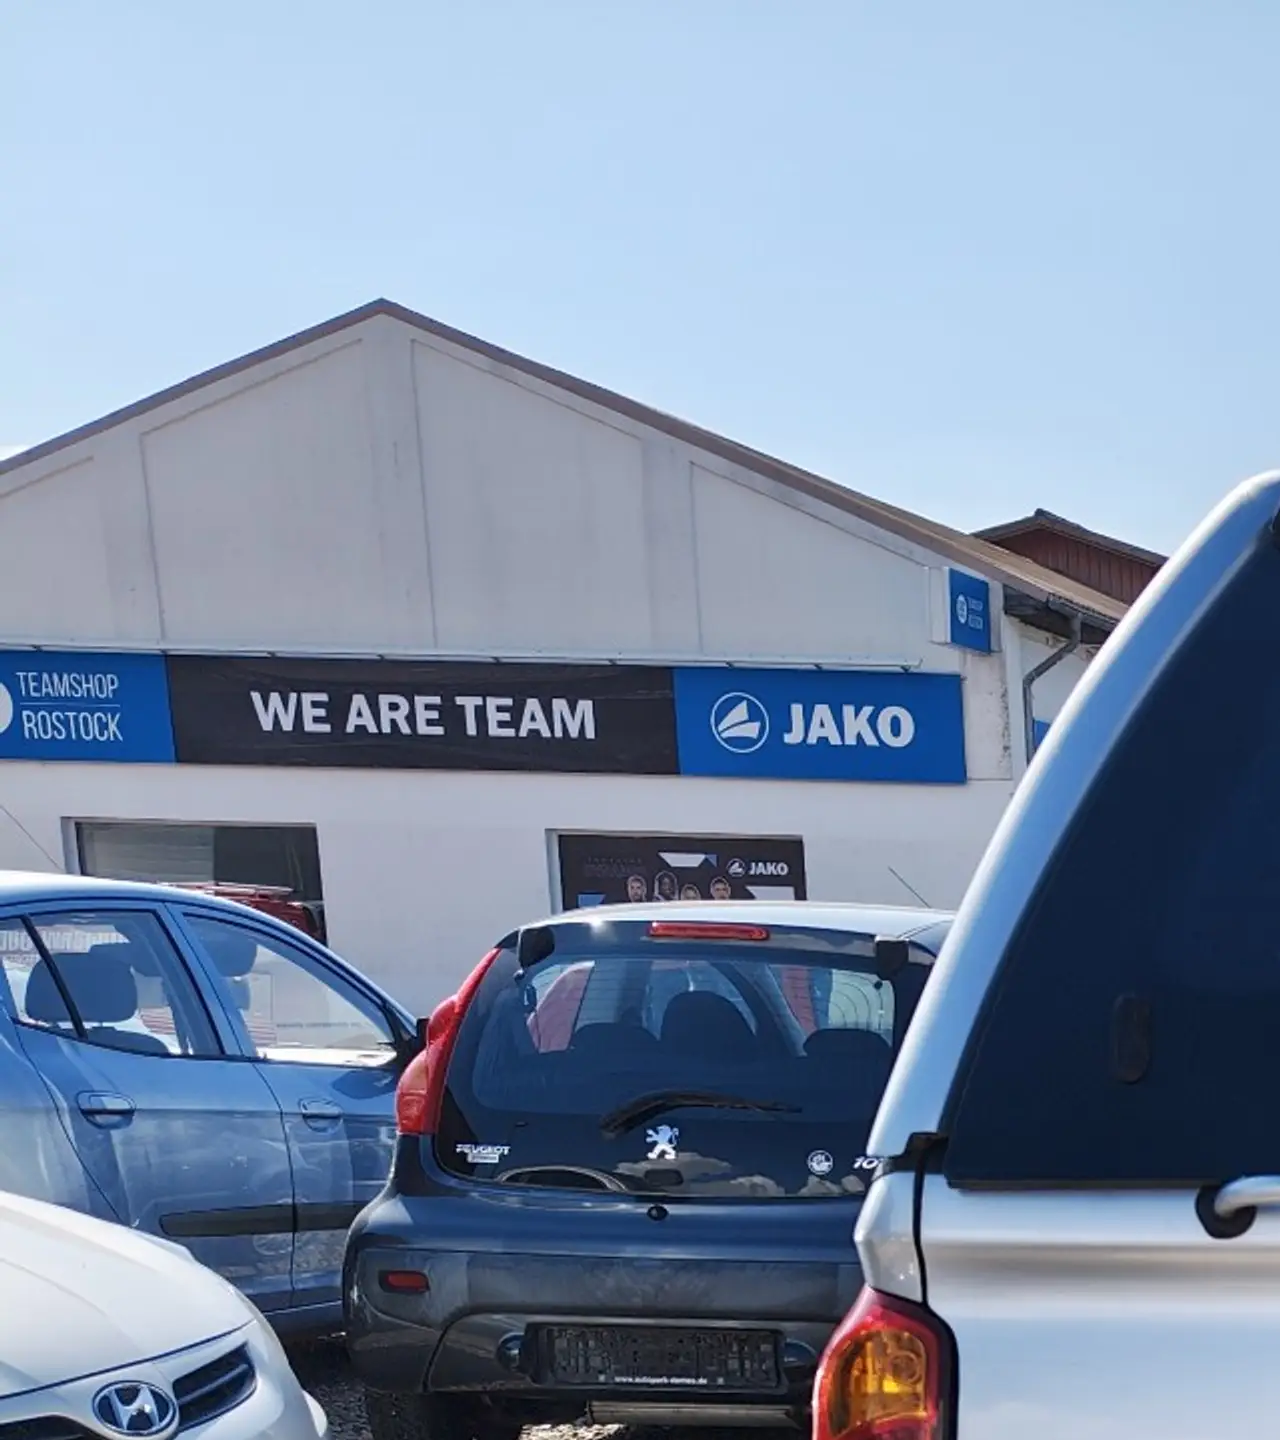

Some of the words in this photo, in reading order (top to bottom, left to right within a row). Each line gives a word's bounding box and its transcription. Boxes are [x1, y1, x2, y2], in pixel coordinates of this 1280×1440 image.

[16, 672, 119, 699] TEAMSHOP
[22, 710, 123, 741] ROSTOCK
[250, 691, 331, 733] WE
[345, 694, 445, 736] ARE
[454, 696, 596, 740] TEAM
[783, 703, 915, 748] JAKO
[749, 861, 789, 875] JAKO
